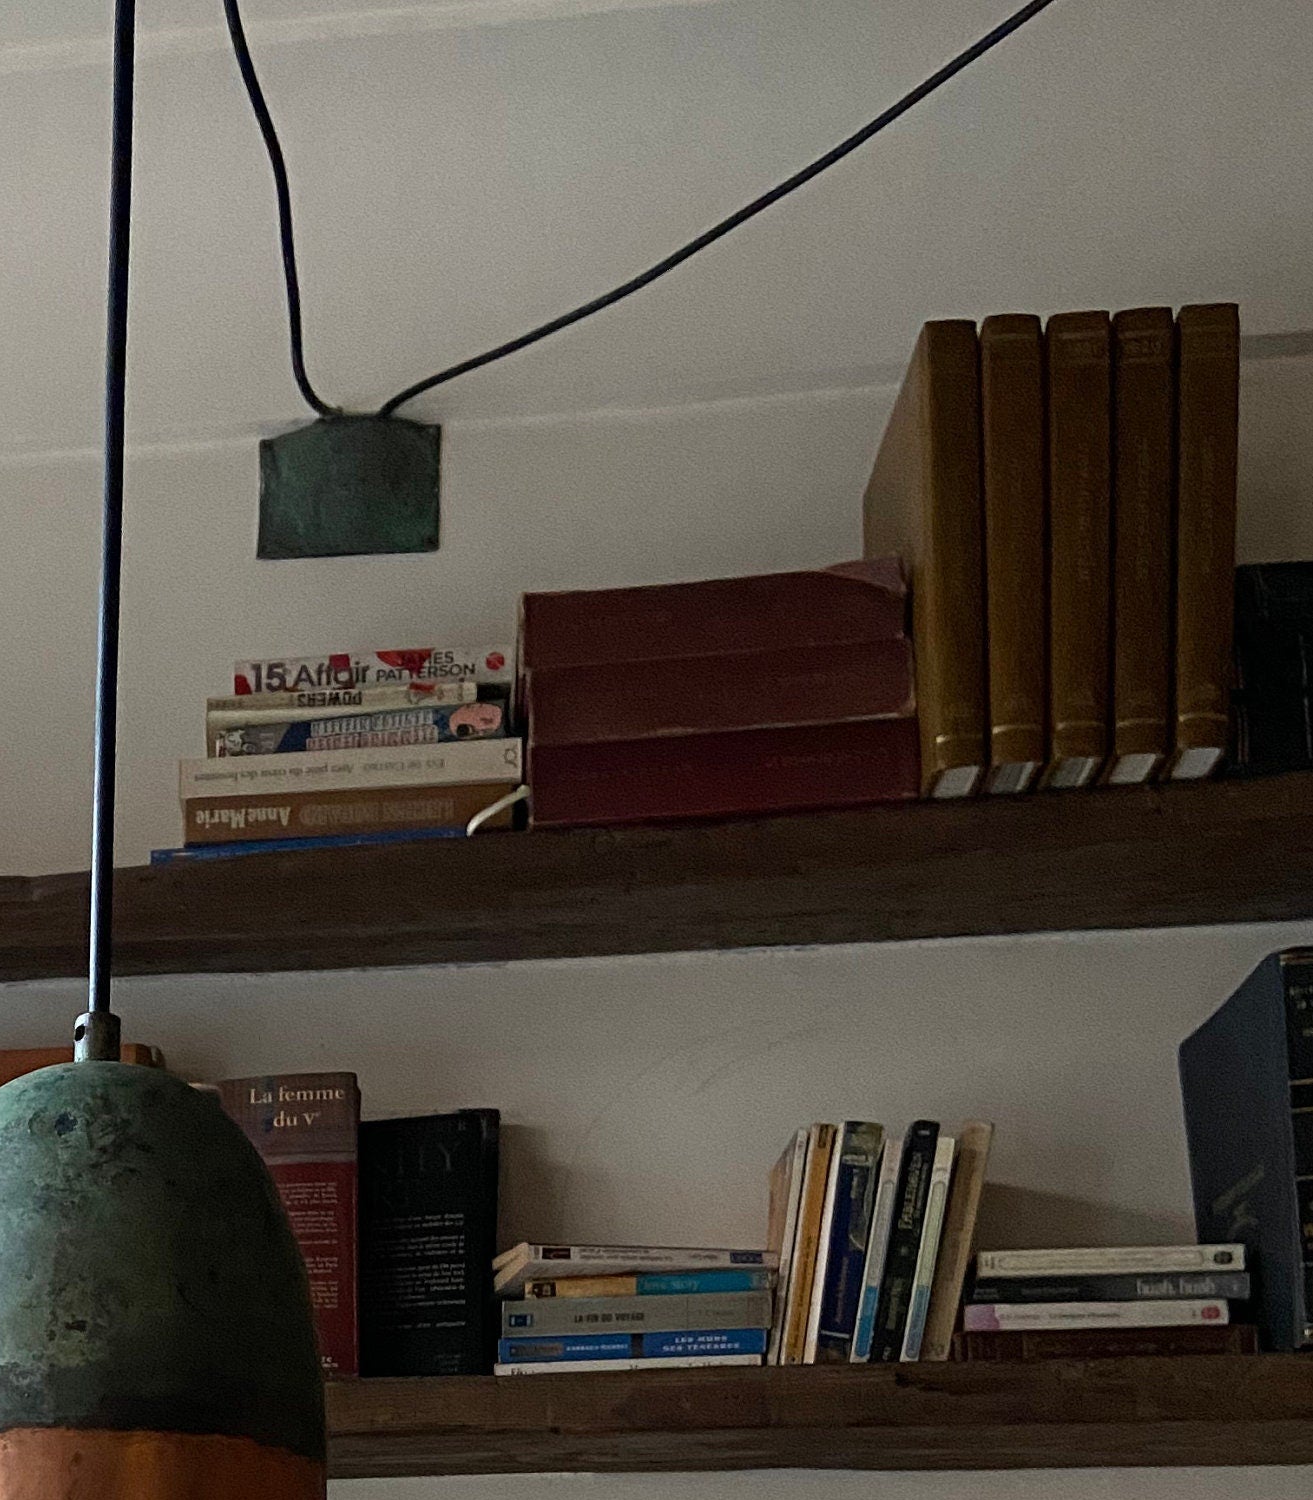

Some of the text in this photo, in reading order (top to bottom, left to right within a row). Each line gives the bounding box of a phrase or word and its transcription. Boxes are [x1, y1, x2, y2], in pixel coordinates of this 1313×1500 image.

[294, 660, 370, 689] Affair
[376, 663, 476, 683] PATTERSON
[296, 689, 363, 708] POWERS
[249, 1085, 345, 1105] La femme
[273, 1110, 298, 1128] du
